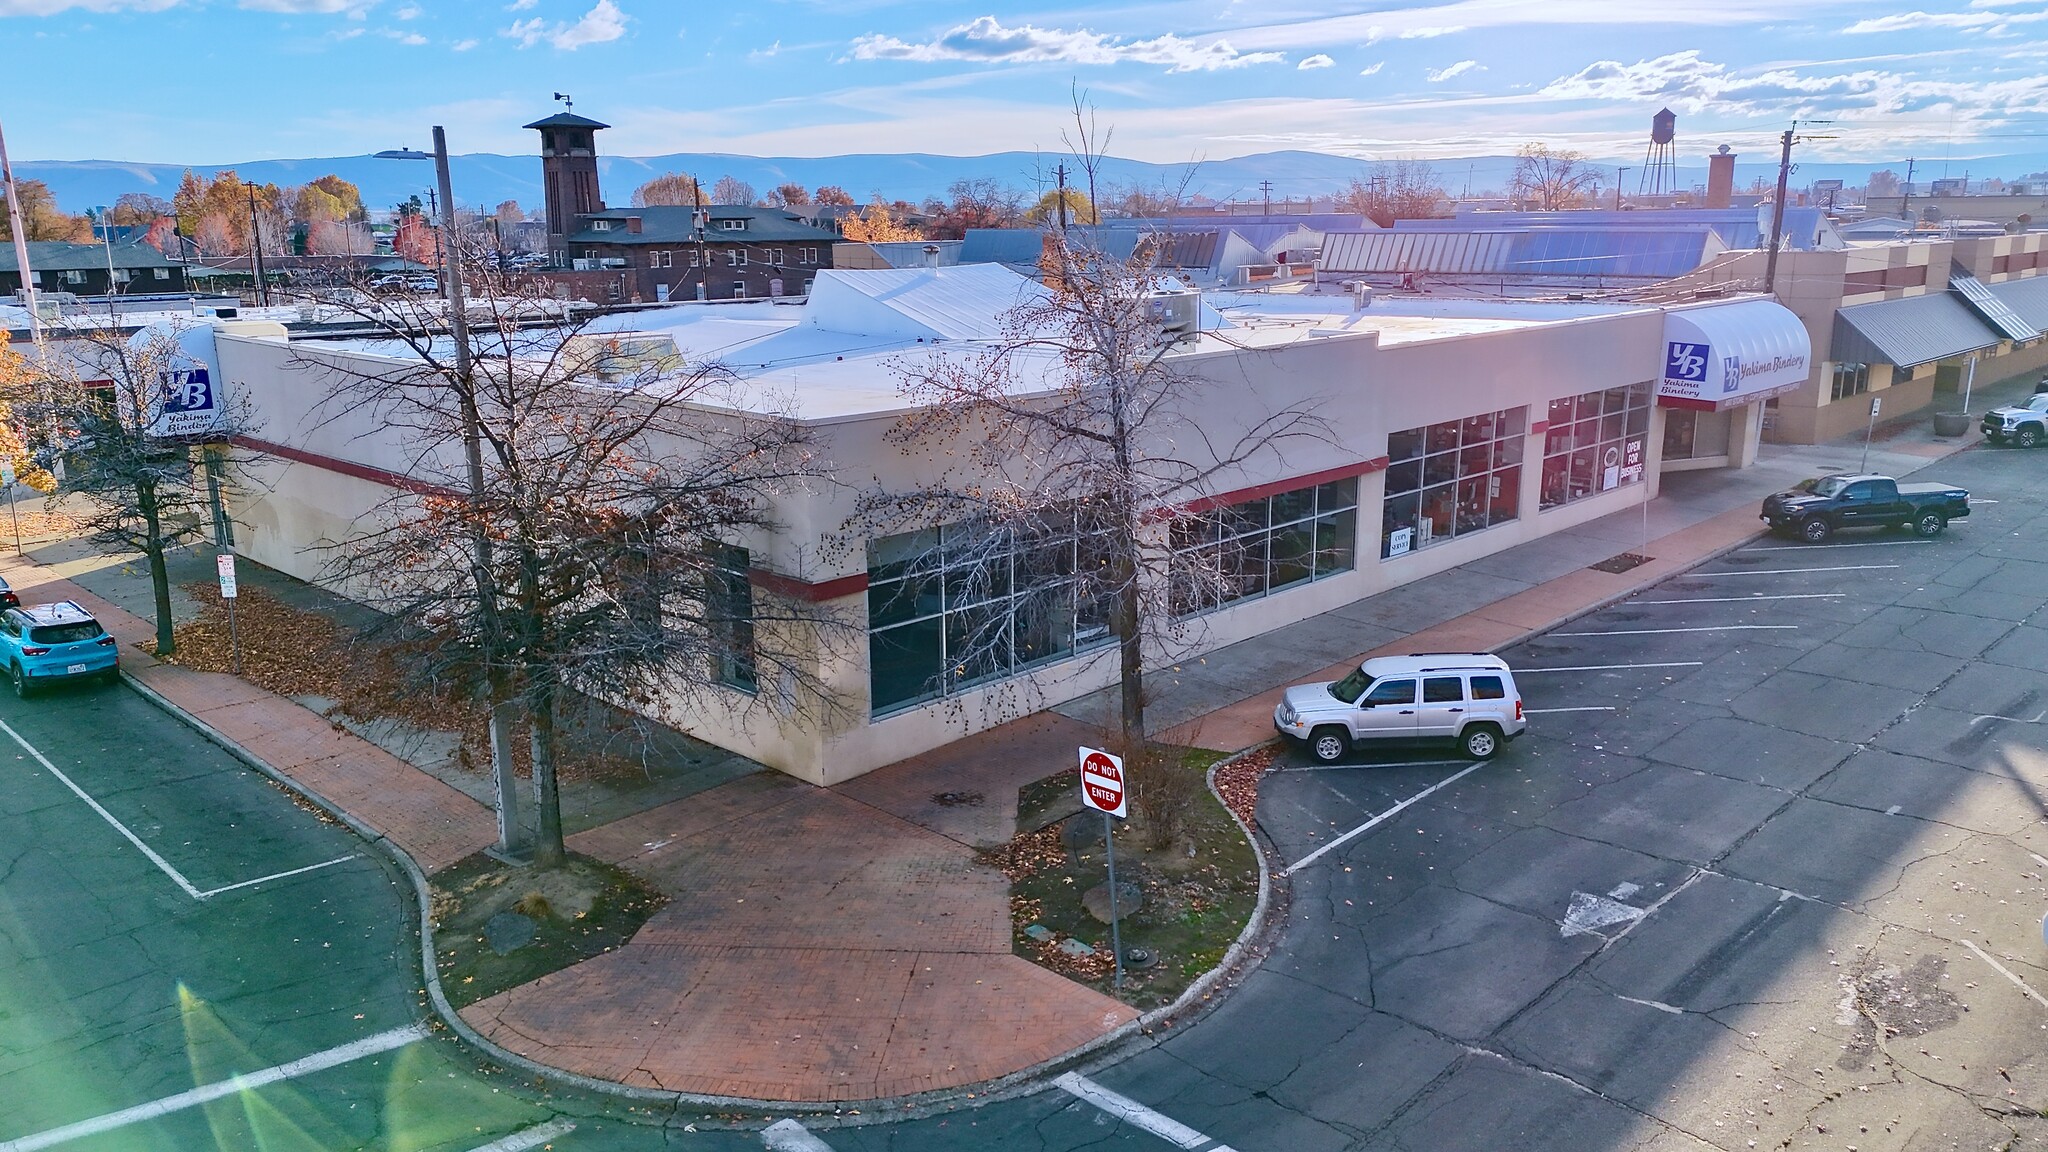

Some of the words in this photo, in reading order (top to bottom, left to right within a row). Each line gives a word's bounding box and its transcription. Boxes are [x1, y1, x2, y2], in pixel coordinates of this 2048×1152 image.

[1740, 361, 1771, 380] Yakima
[1773, 354, 1804, 373] Bindery
[1664, 379, 1699, 388] Yakima
[1661, 386, 1700, 397] Bindery
[168, 414, 211, 423] Yakima
[1627, 440, 1641, 453] OPEN
[1628, 453, 1638, 465] FOR
[1621, 463, 1642, 478] BUSINESS
[1087, 761, 1097, 772] DO
[1101, 765, 1116, 778] NOT
[1091, 787, 1116, 803] ENTER
